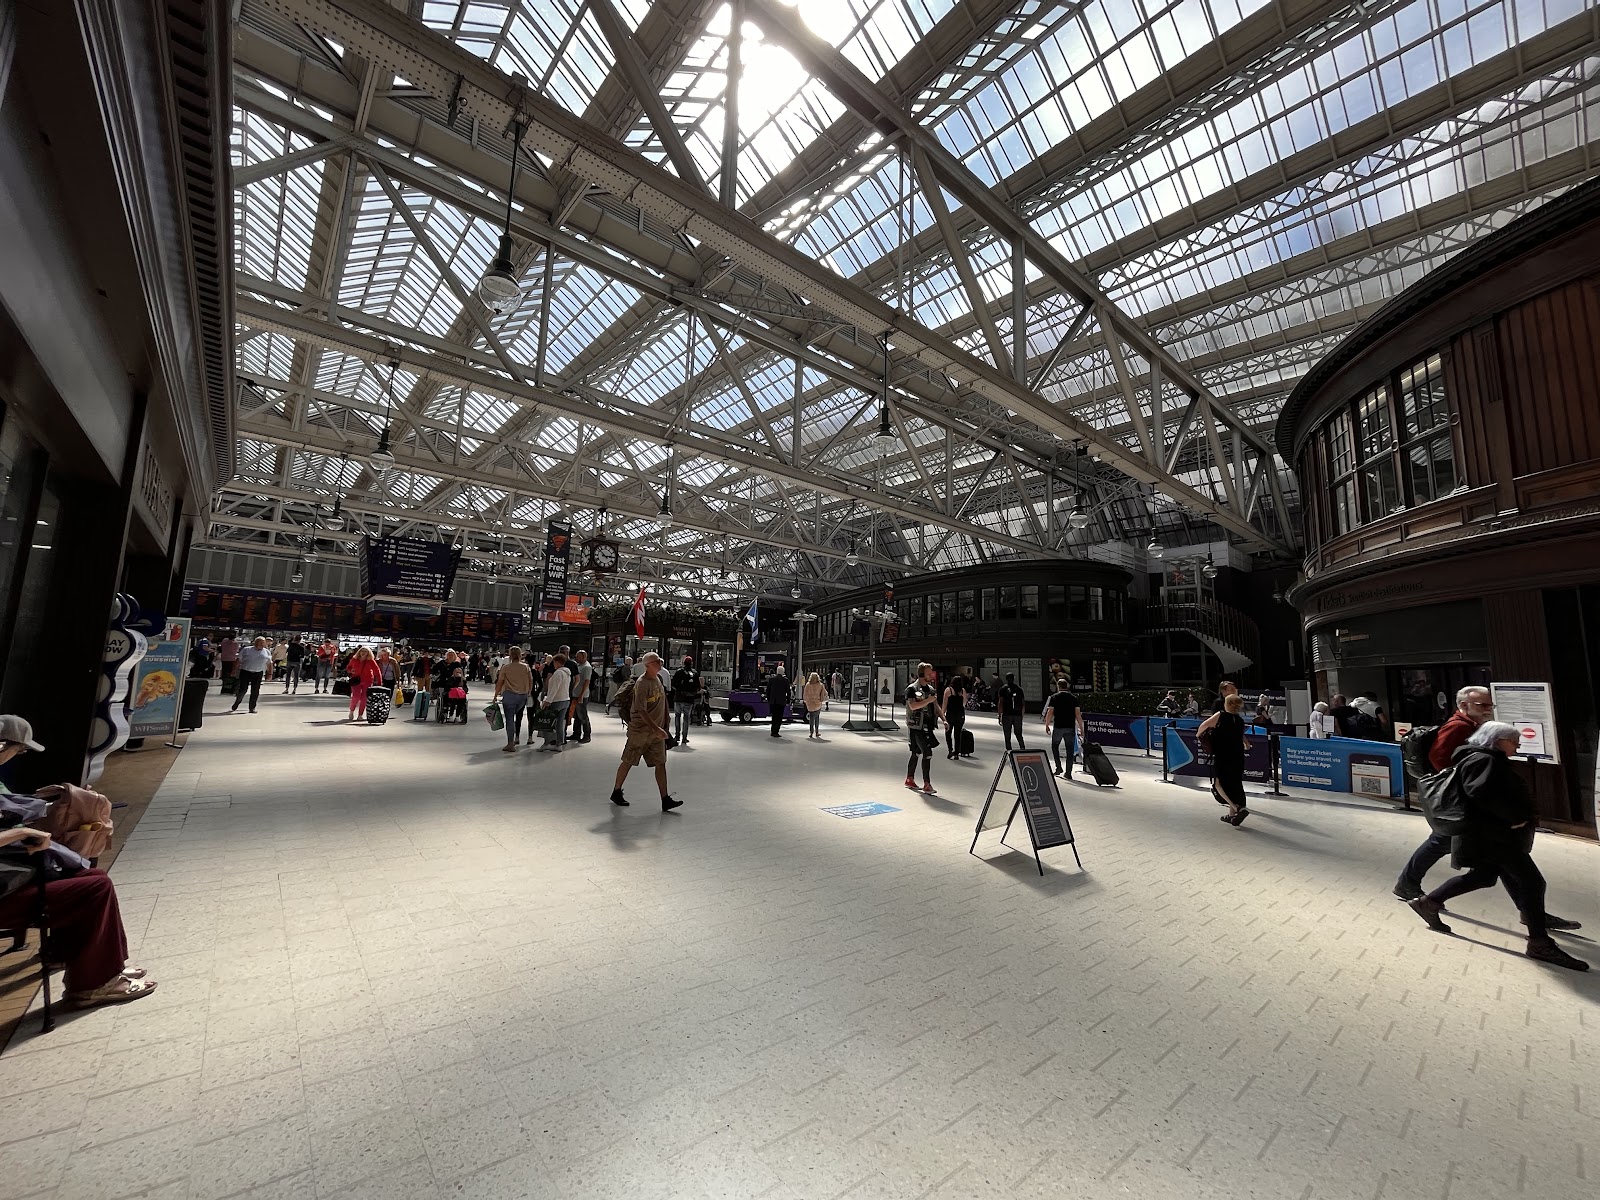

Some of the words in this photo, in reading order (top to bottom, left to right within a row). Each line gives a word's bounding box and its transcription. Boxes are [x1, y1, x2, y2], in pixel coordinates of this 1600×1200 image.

[549, 554, 566, 564] Fast
[548, 562, 565, 572] Free
[548, 570, 565, 579] WiFi
[1287, 747, 1298, 755] Buy
